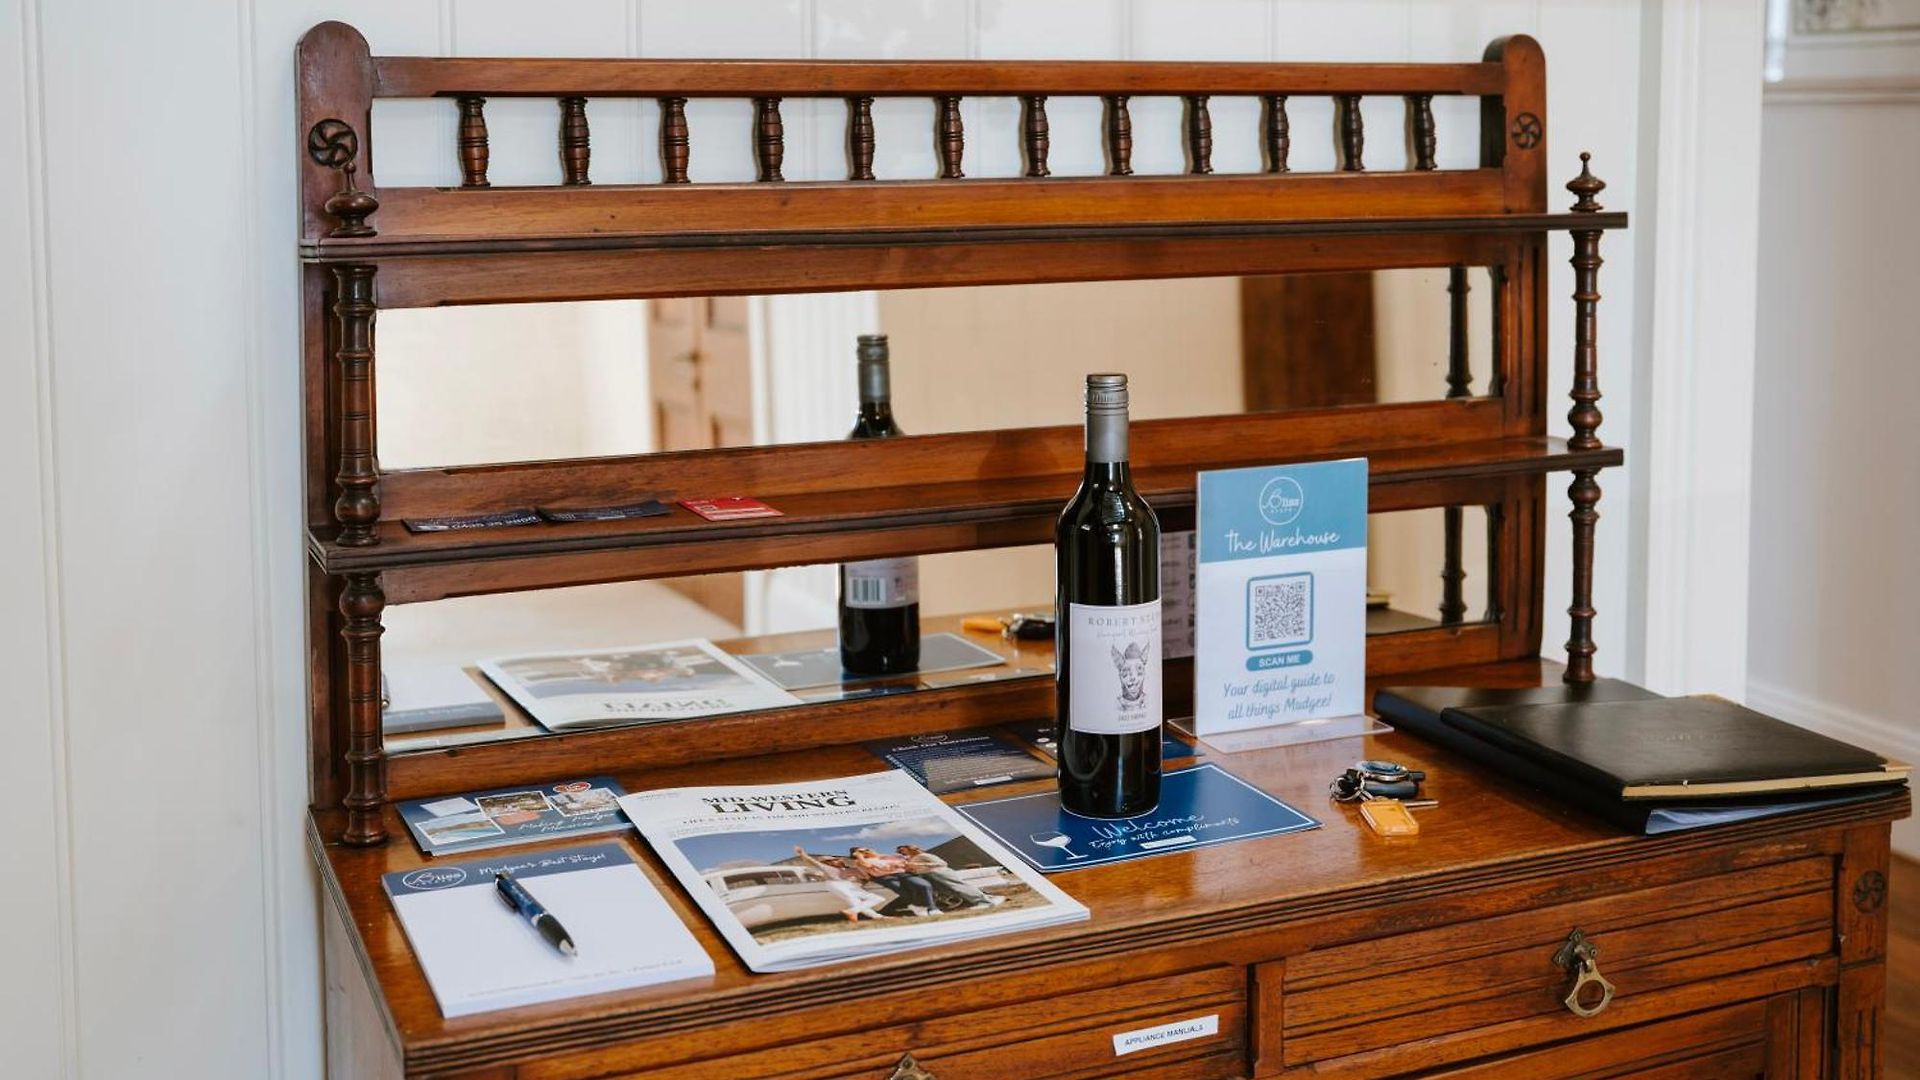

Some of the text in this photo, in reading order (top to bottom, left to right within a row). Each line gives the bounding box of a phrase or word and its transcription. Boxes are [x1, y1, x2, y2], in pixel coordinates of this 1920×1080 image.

[1260, 528, 1340, 554] Warehouse
[1088, 615, 1137, 627] ROBERT
[1259, 652, 1302, 668] SCAN ME
[1223, 671, 1337, 698] Your digital guide to
[1228, 691, 1334, 720] all things Mudgee!
[702, 789, 849, 803] MID-WESTERN
[711, 796, 857, 813] LIVING
[1088, 817, 1240, 851] Enjoy with compliments
[1091, 814, 1205, 839] Welcome
[1124, 1032, 1165, 1046] APPLIANCE
